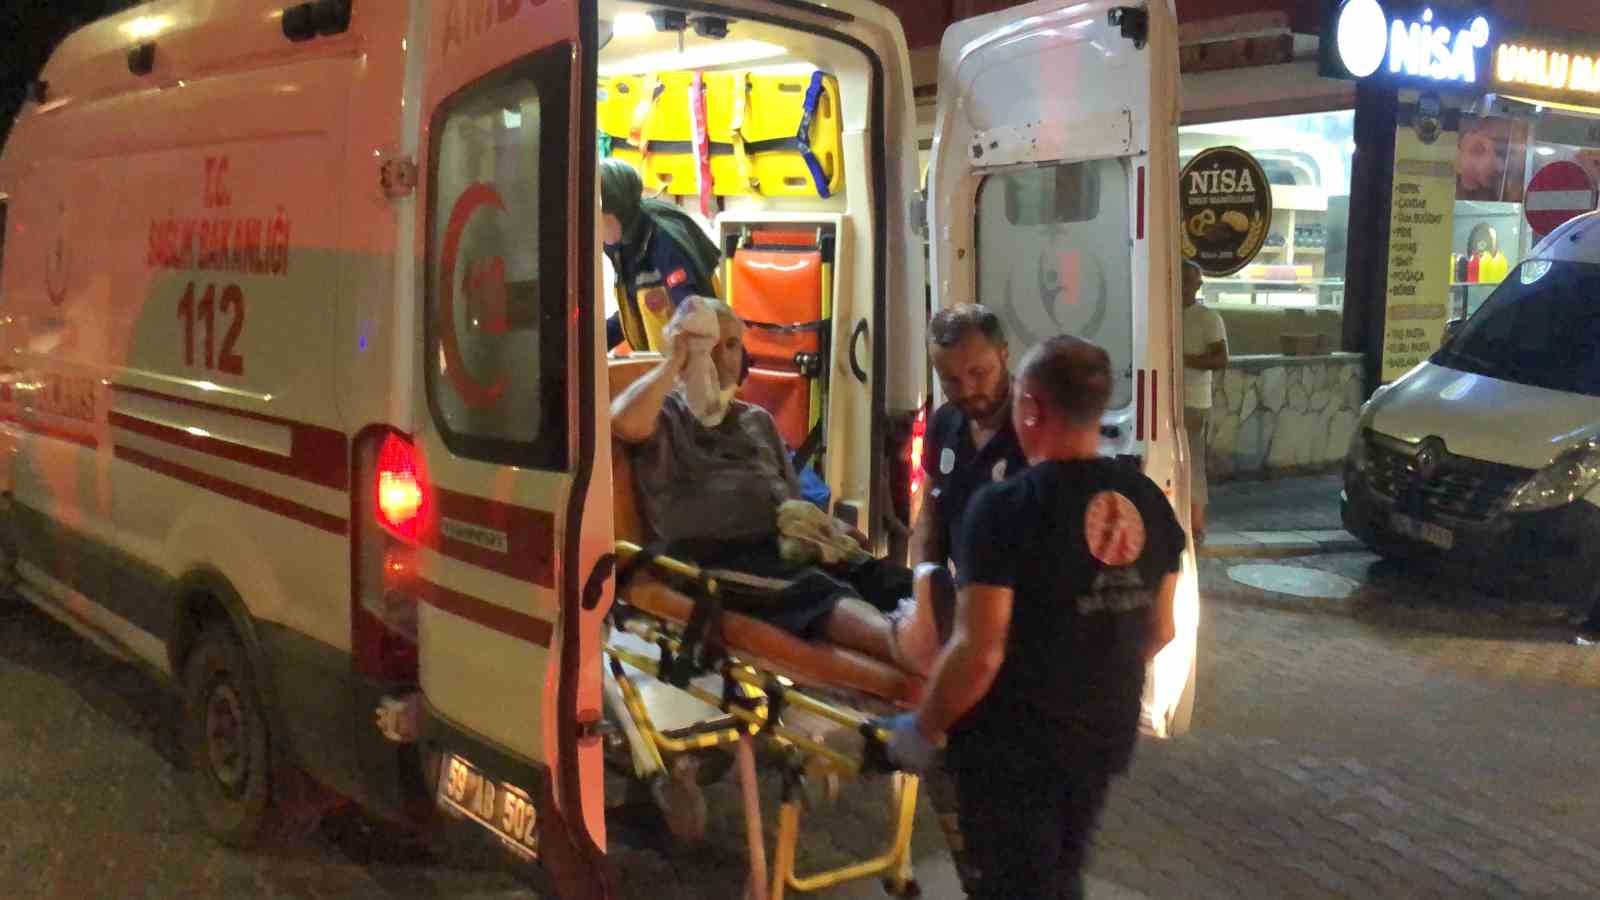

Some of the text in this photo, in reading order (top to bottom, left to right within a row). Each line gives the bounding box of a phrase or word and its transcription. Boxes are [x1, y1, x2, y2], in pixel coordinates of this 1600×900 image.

[1189, 162, 1256, 194] NİSA
[176, 279, 244, 376] 112
[503, 792, 537, 846] 502
